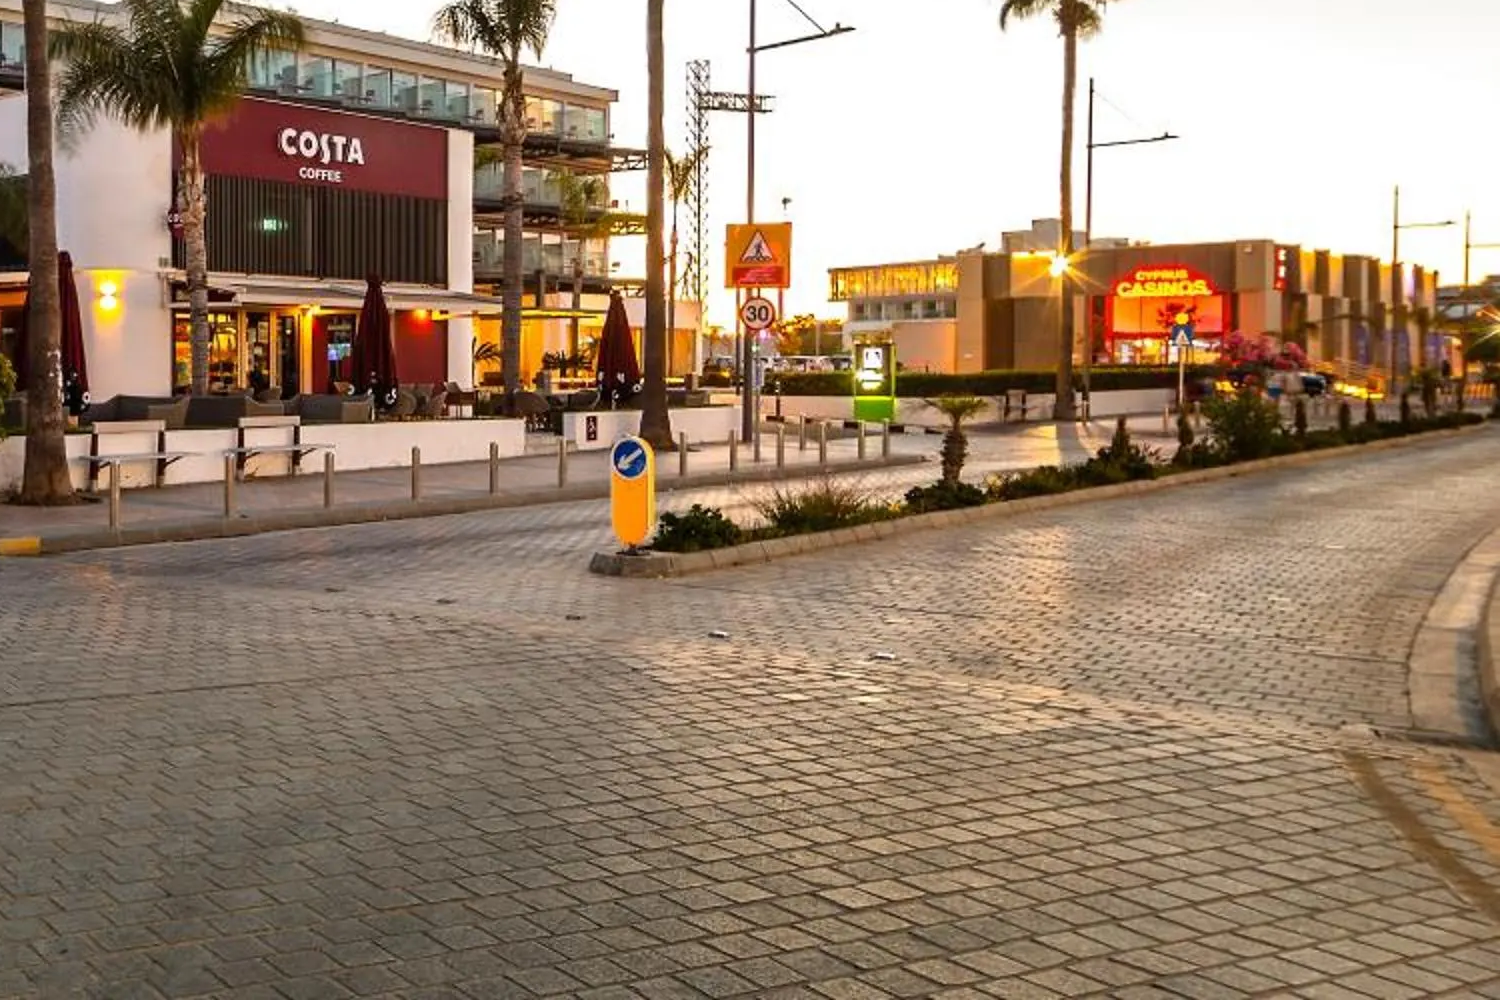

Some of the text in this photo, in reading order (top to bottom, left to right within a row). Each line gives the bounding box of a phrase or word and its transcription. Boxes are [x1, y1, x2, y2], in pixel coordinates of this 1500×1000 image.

[280, 127, 365, 165] COSTA
[299, 167, 342, 183] COFFEE
[1116, 279, 1210, 297] CASINOS
[745, 305, 769, 322] 30
